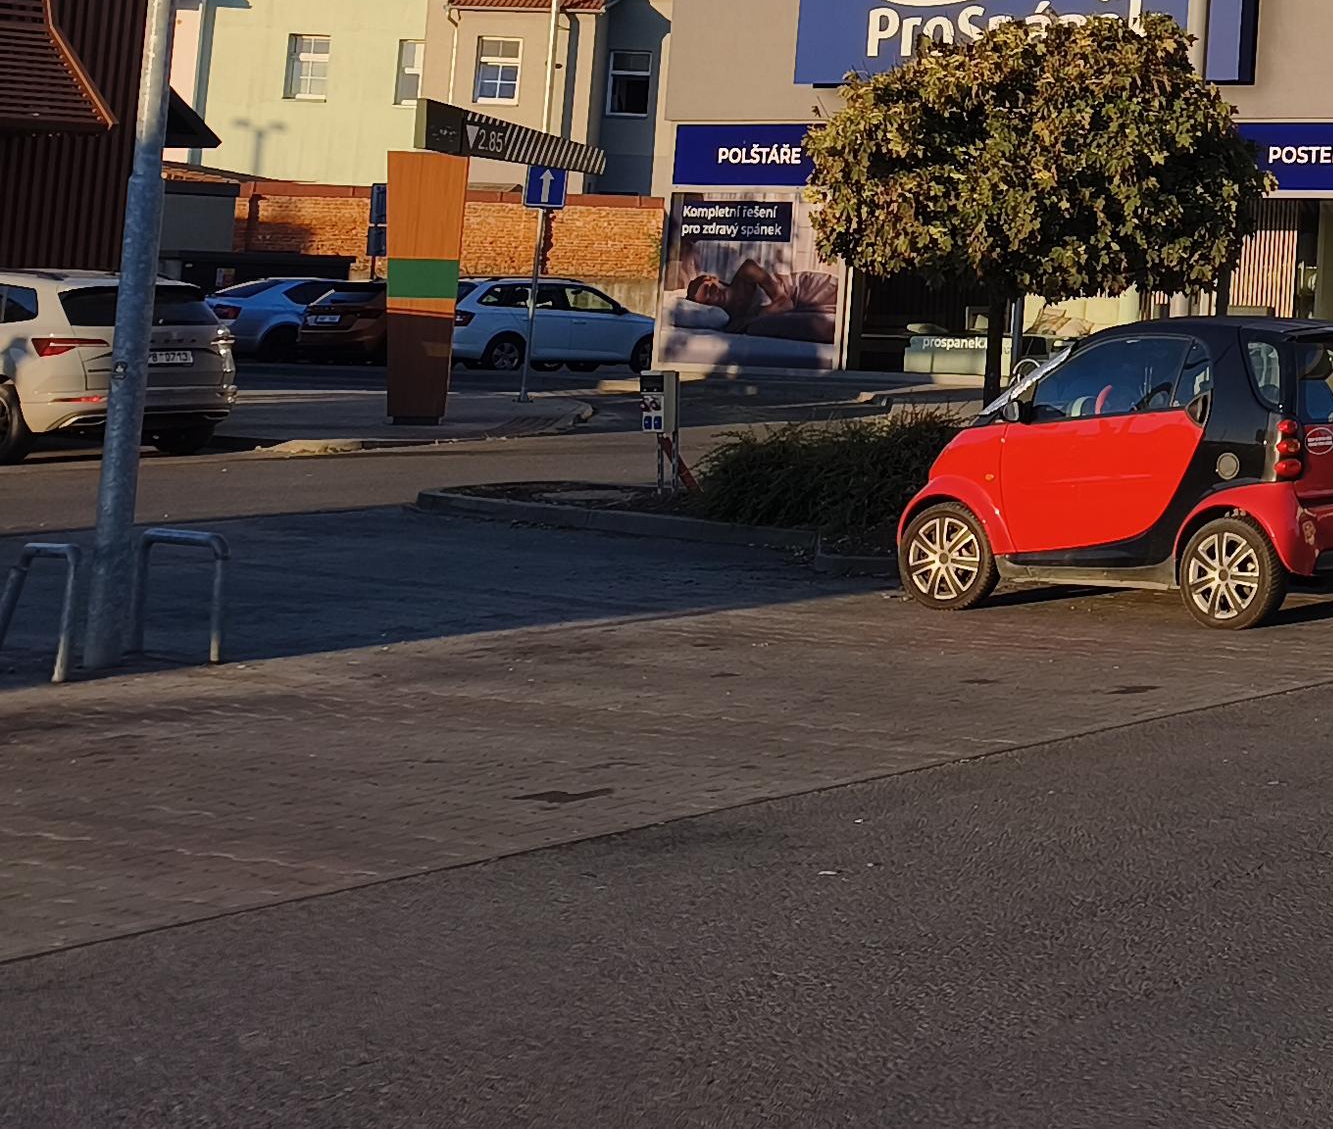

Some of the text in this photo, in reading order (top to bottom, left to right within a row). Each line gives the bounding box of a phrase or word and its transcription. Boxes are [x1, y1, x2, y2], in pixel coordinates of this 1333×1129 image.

[478, 129, 504, 153] 2.85
[717, 143, 802, 165] POLŠTÁŘE
[683, 205, 778, 221] Kompletní řešení
[681, 223, 782, 237] pro zdravý spánek
